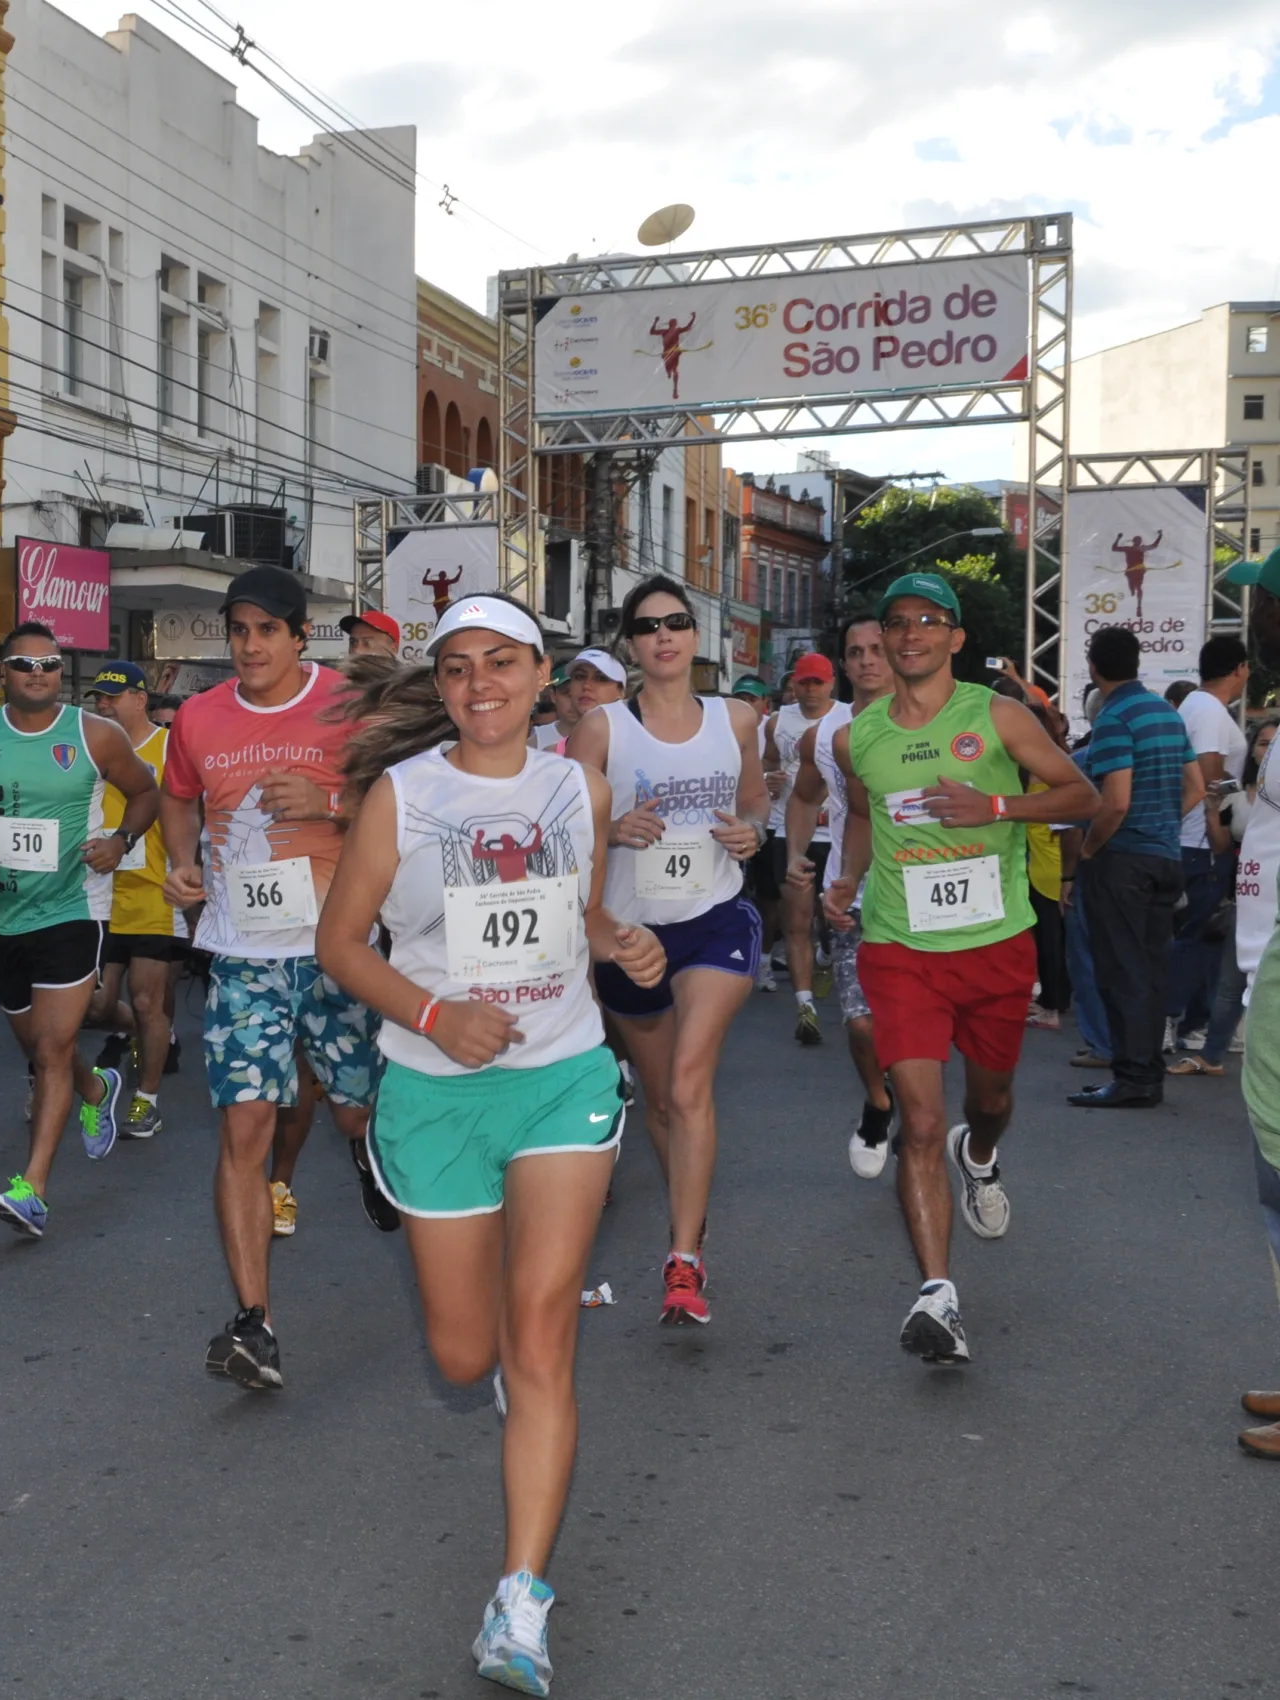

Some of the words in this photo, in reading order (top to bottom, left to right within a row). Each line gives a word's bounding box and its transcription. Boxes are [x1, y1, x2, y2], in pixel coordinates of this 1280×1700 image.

[735, 303, 776, 329] 36ª
[783, 290, 931, 334] Corrida
[943, 284, 997, 320] de
[783, 341, 860, 377] São
[873, 330, 997, 371] Pedro
[20, 546, 109, 613] Glamour
[402, 622, 434, 641] 36ª
[1160, 617, 1184, 633] de
[1140, 637, 1184, 653] edro
[204, 742, 323, 769] equilibrium
[901, 748, 941, 763] POGIAN
[653, 771, 736, 797] circuito
[12, 833, 42, 853] 510
[665, 854, 690, 878] 49
[1244, 859, 1260, 876] de
[243, 880, 283, 908] 366
[930, 879, 969, 906] 487
[1236, 879, 1260, 896] edro
[482, 908, 539, 948] 492
[516, 983, 564, 1004] Pedro
